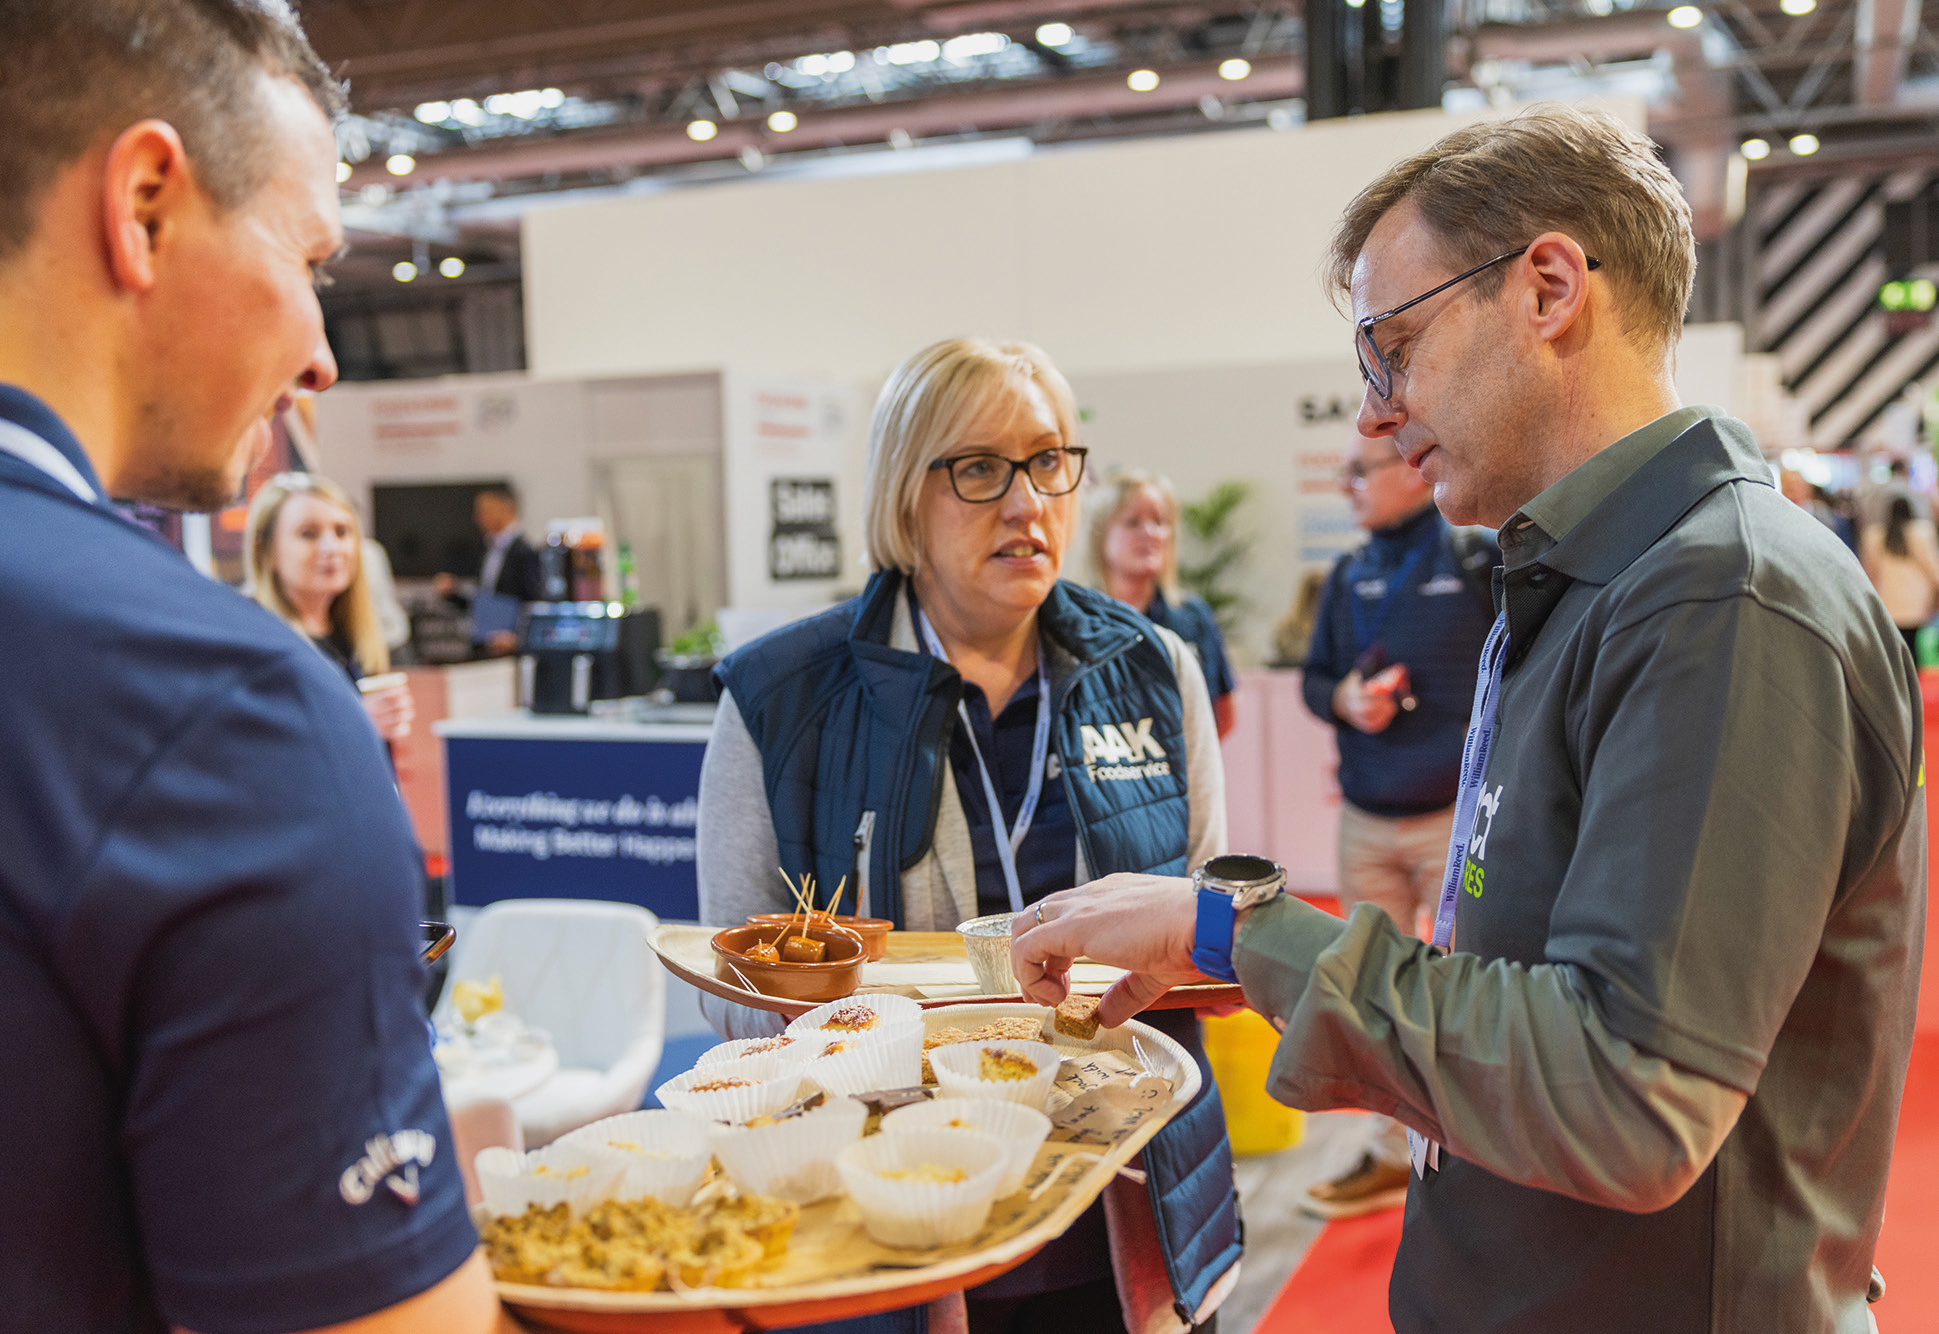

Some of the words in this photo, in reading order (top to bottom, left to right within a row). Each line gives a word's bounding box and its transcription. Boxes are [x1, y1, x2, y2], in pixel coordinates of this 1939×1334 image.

[1079, 716, 1168, 765] AAK
[1469, 727, 1492, 789] WilliamReed.
[1086, 758, 1171, 783] Foodservice
[619, 831, 697, 866] Happe
[1446, 843, 1466, 902] WilliamReed.
